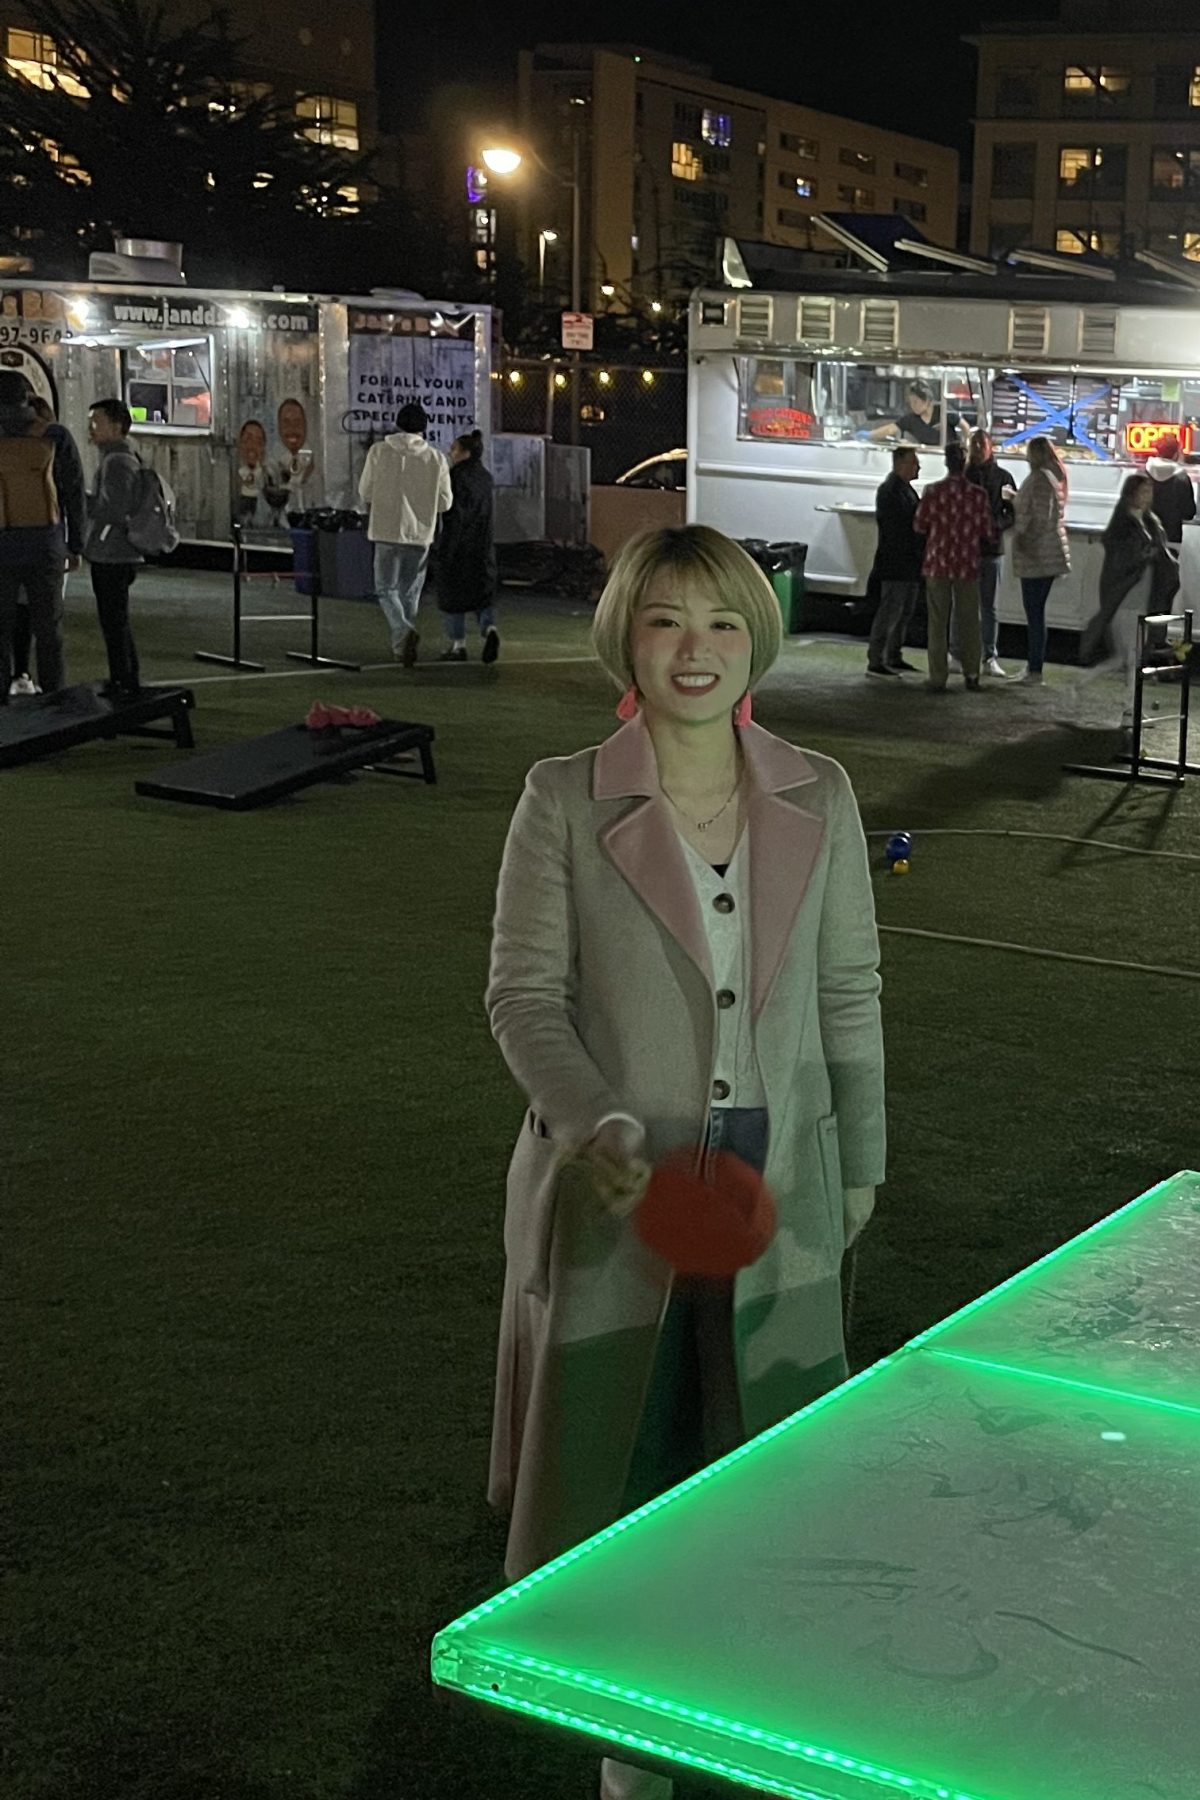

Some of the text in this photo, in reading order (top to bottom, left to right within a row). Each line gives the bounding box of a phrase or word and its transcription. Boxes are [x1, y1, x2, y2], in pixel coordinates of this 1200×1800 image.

[360, 375, 464, 390] FOR ALL YOUR
[357, 392, 467, 408] CATERING AND
[353, 410, 474, 426] SPECI VENTS
